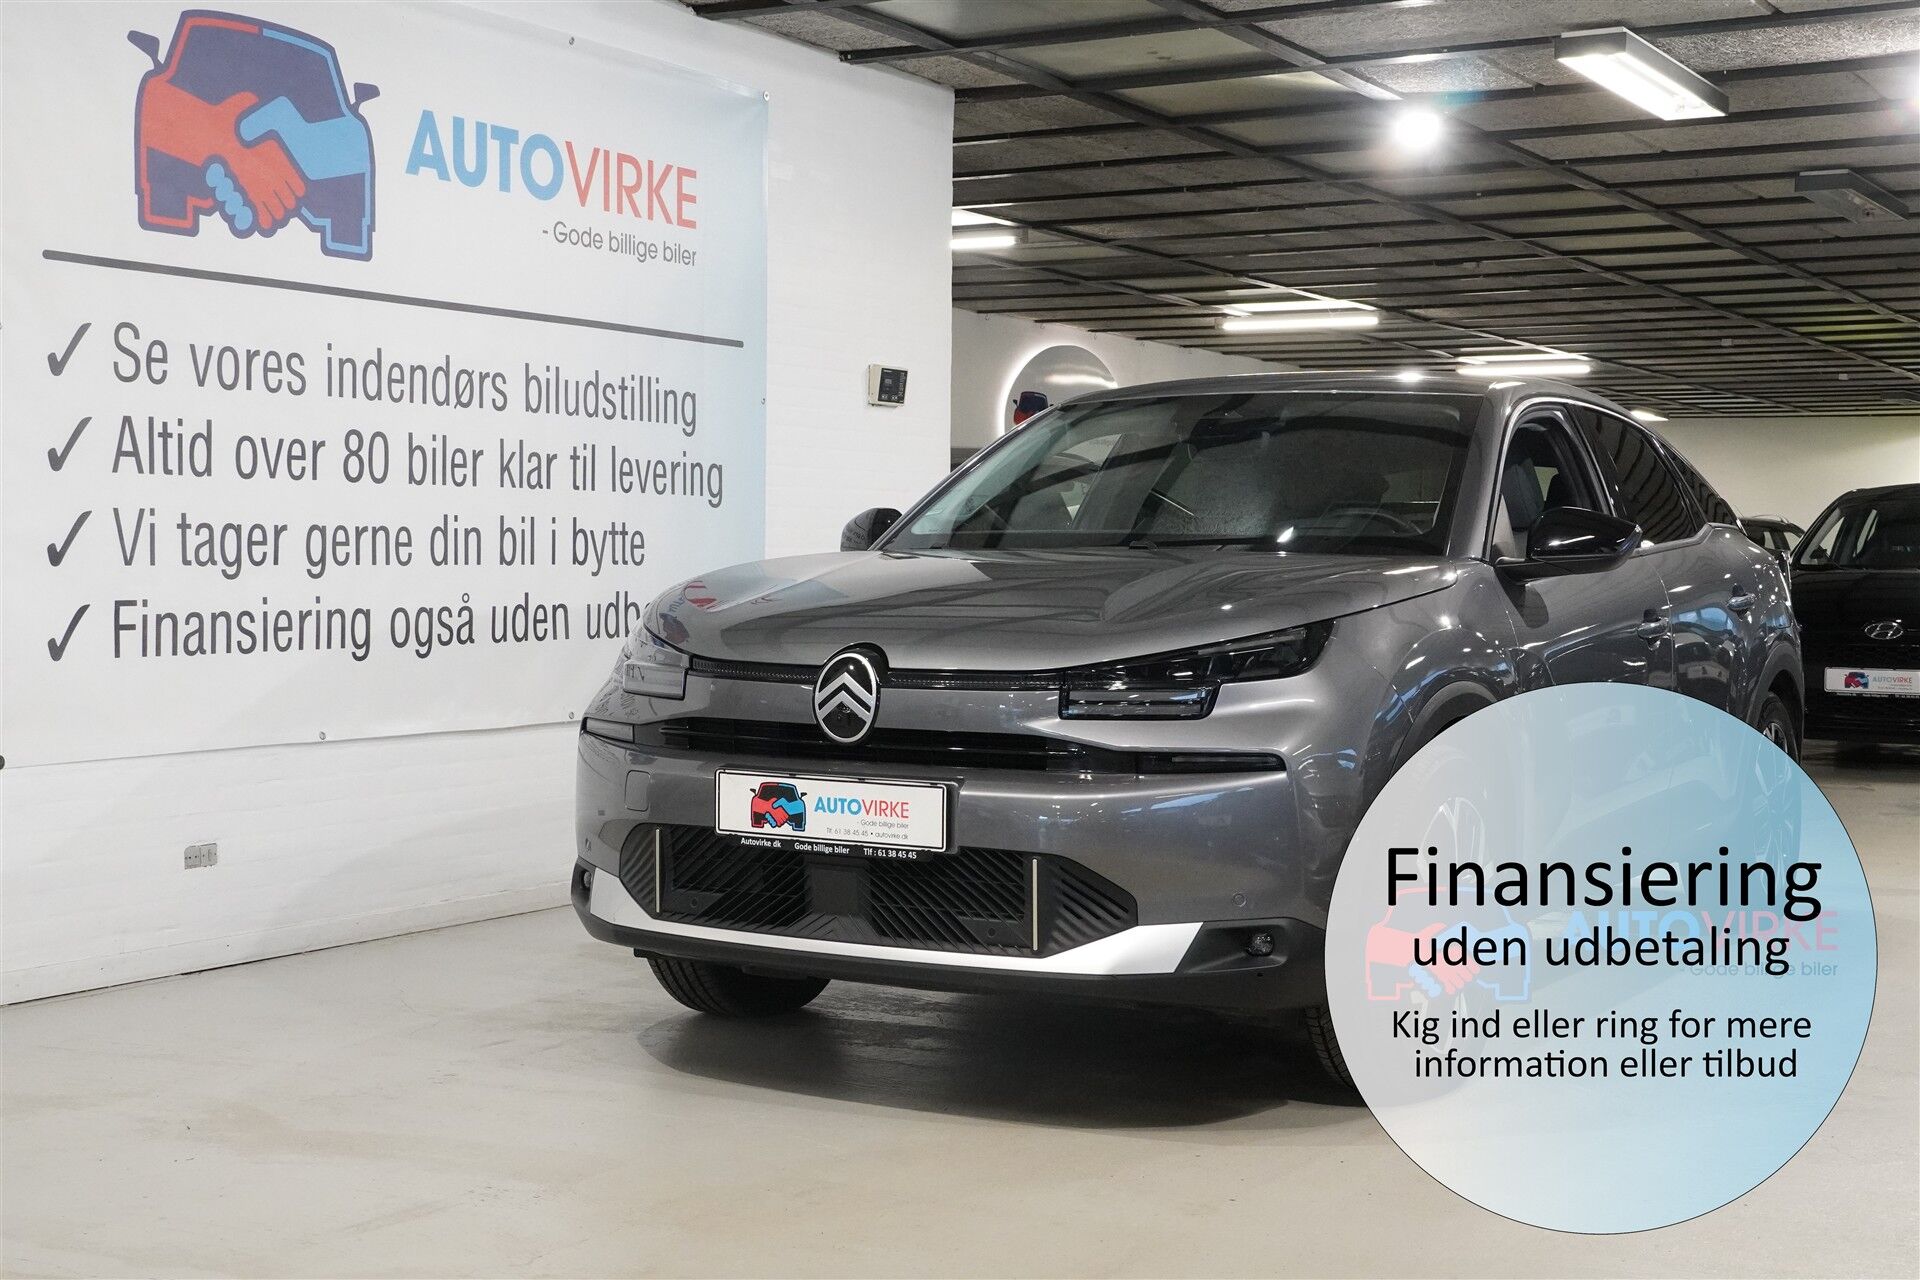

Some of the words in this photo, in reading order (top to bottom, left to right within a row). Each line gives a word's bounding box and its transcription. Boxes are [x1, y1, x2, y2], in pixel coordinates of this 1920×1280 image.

[405, 109, 697, 231] AUTOVIRKE
[553, 221, 604, 250] Gode
[608, 230, 658, 263] billige
[663, 240, 697, 267] biler
[113, 321, 168, 385] Se
[189, 343, 307, 396] vores
[327, 342, 508, 412] indendørs
[524, 362, 697, 437] biludstilling
[111, 415, 213, 478] Altid
[235, 435, 326, 481] over
[343, 428, 390, 485] 80
[408, 432, 484, 488] biler
[499, 438, 558, 490] klar
[569, 443, 596, 492] til
[611, 445, 723, 509] levering
[112, 507, 156, 567] Vi
[176, 512, 288, 581] tager
[305, 524, 413, 580] gerne
[430, 513, 482, 567] din
[499, 515, 535, 567] bil
[551, 516, 556, 566] i
[572, 516, 645, 577] bytte
[113, 595, 371, 662] Finansiering
[390, 592, 476, 660] også
[491, 591, 570, 644] uden
[587, 590, 650, 640] udb
[814, 796, 910, 818] AUTOVIRKE
[861, 819, 877, 827] Gode
[879, 821, 895, 829] billige
[741, 837, 771, 847] Autovirke
[794, 842, 812, 851] Gode
[813, 844, 833, 853] billige
[834, 846, 850, 854] biler
[877, 849, 886, 857] 61
[887, 850, 896, 858] 38
[908, 851, 917, 859] 45
